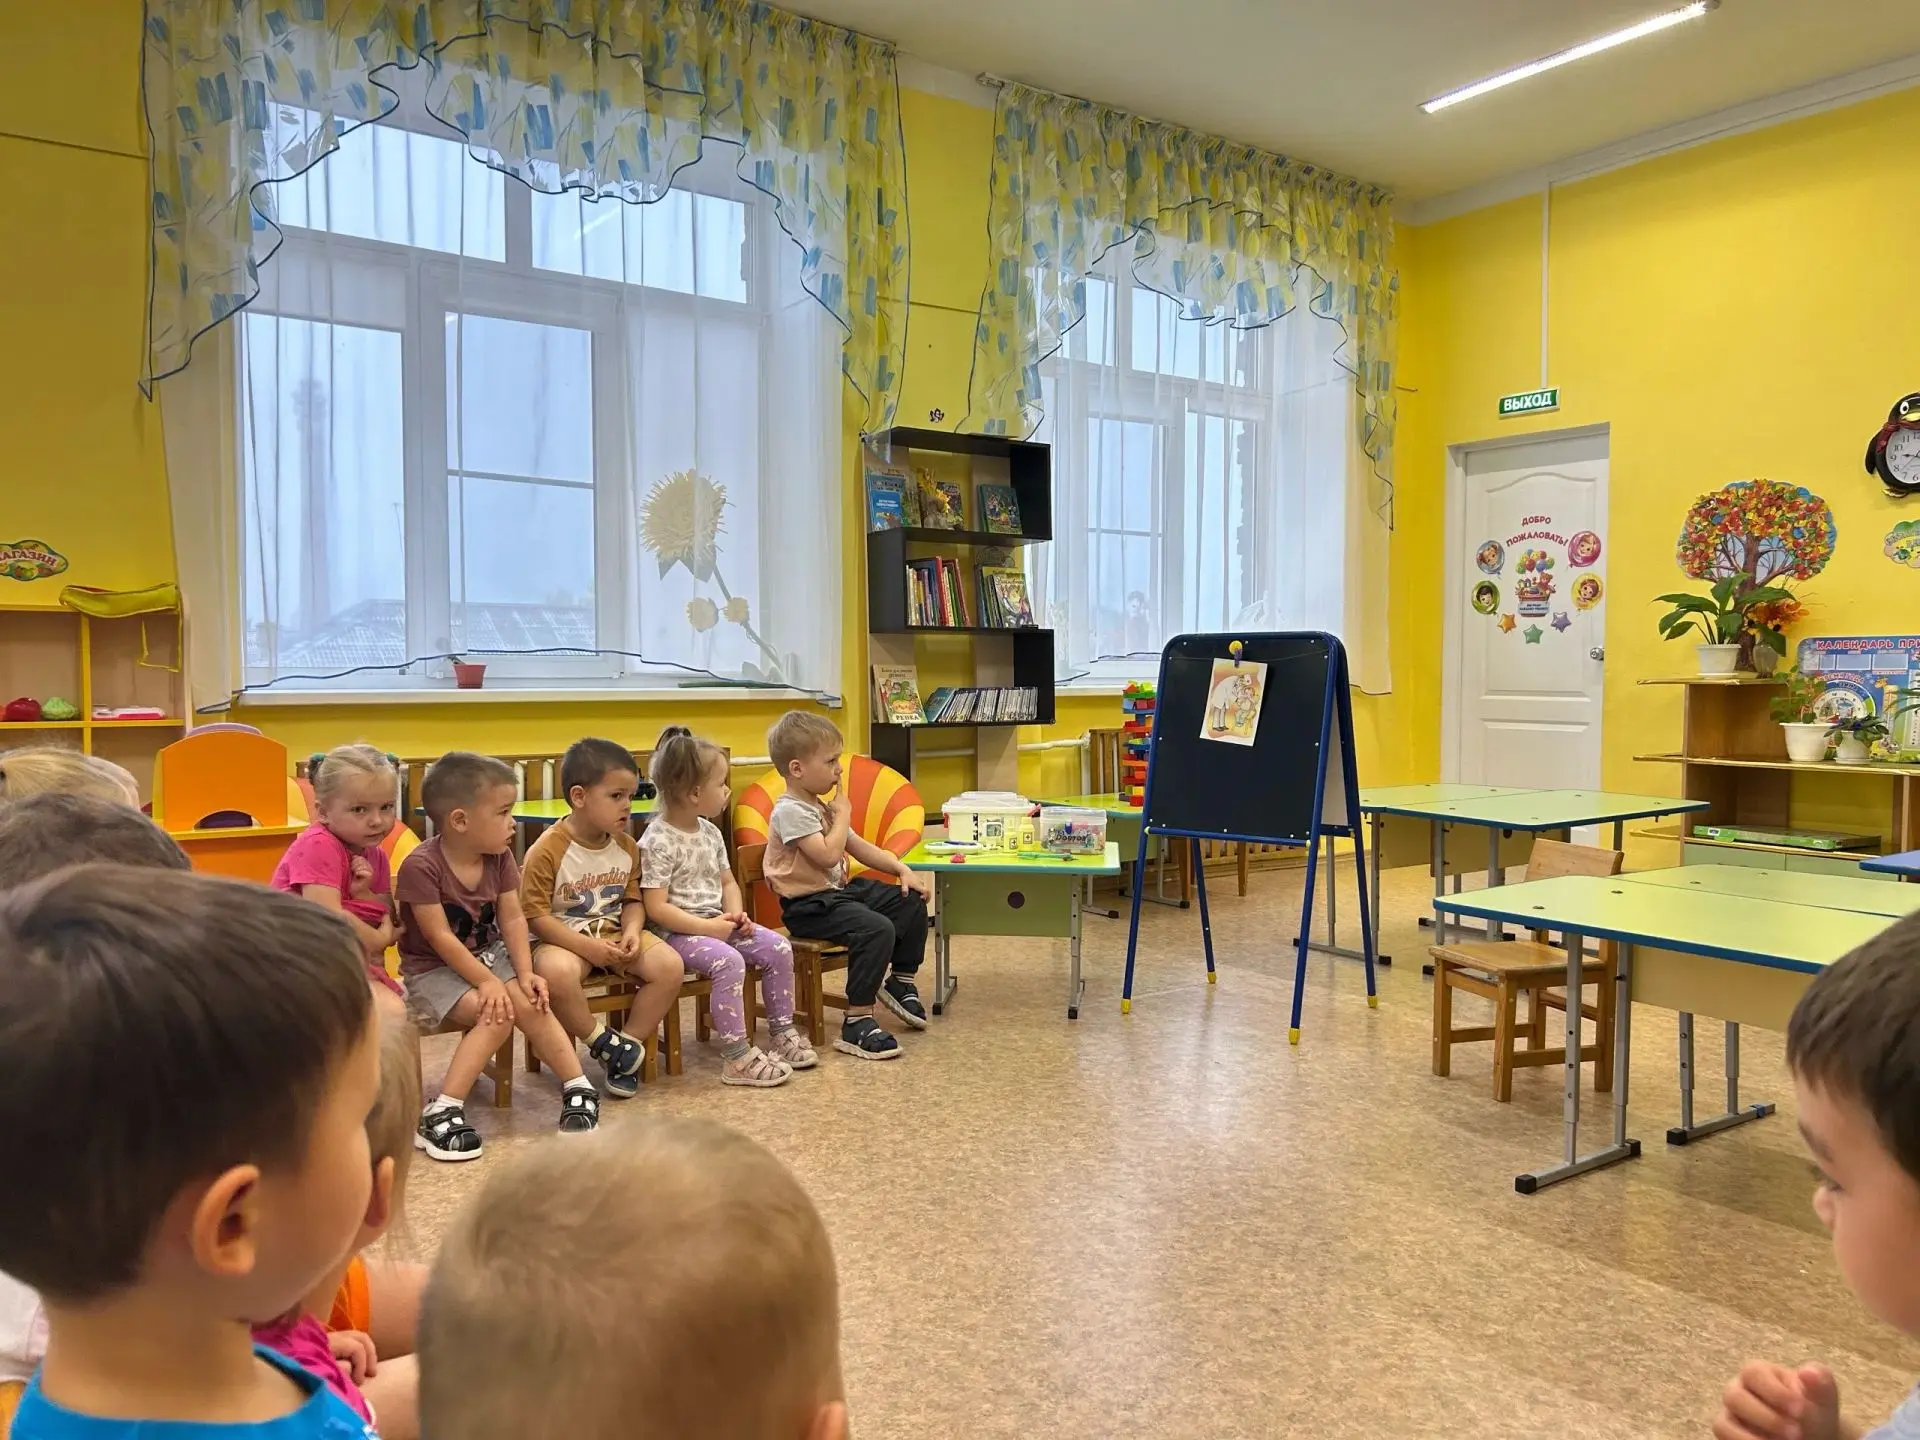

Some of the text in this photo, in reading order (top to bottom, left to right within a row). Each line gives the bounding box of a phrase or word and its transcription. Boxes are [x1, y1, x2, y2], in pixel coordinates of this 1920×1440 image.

[1503, 392, 1552, 411] ВЫХОД
[1902, 435, 1910, 443] 11
[1894, 443, 1903, 451] 10
[1893, 464, 1900, 472] 8
[1902, 471, 1908, 480] 7
[1521, 515, 1551, 527] ДОБРО
[1505, 531, 1569, 547] ПОЖАЛОВАТЬ!
[0, 549, 57, 567] АГАЗИН
[1816, 640, 1895, 651] КАЛЕНДАРЬ
[556, 867, 630, 901] Motivatio
